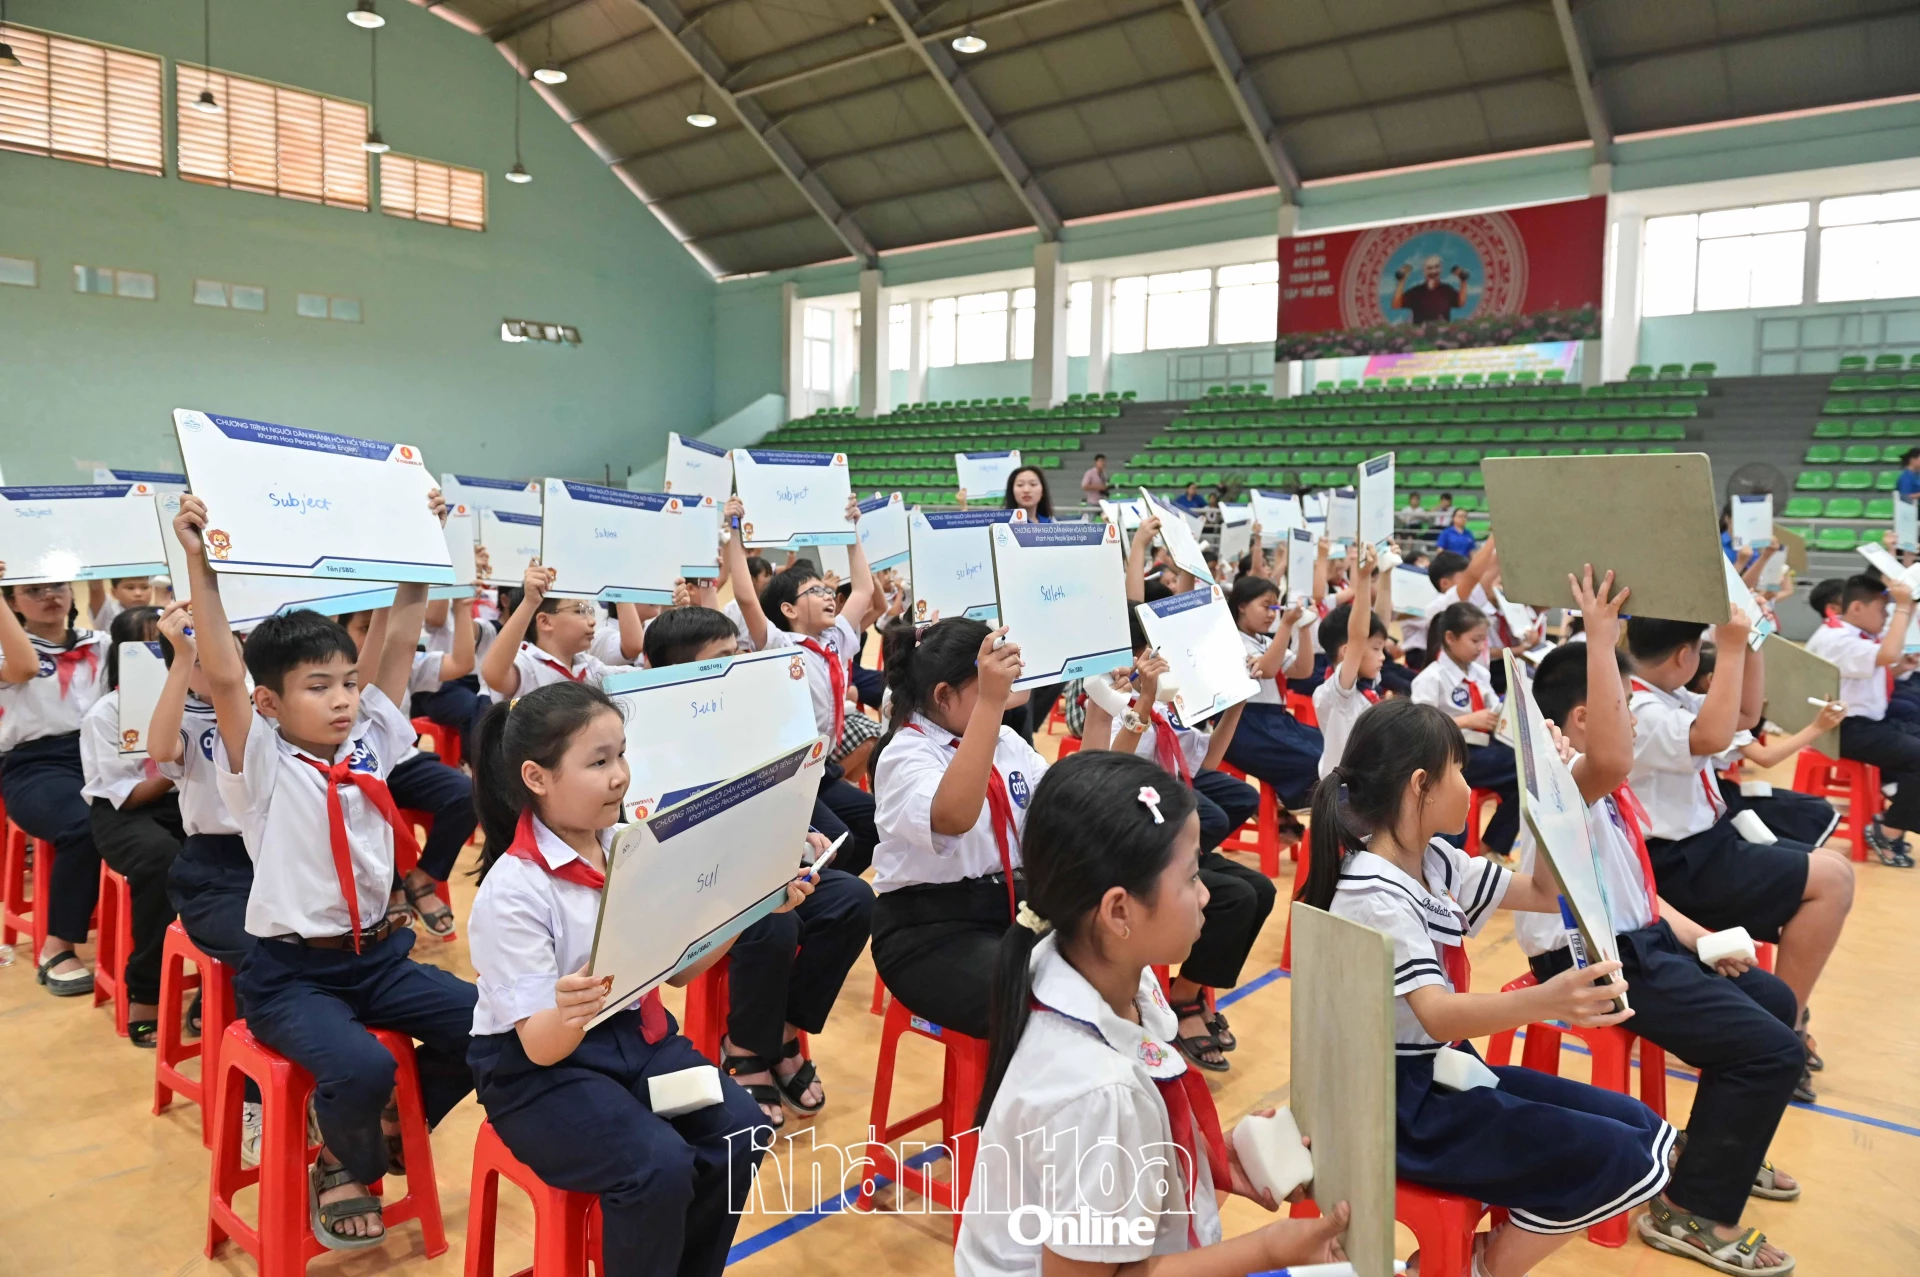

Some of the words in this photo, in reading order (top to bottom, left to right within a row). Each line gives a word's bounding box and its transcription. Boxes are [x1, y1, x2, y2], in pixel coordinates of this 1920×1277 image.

[269, 492, 332, 514] Subject
[1013, 781, 1026, 795] 013
[1423, 898, 1452, 917] Charlotte
